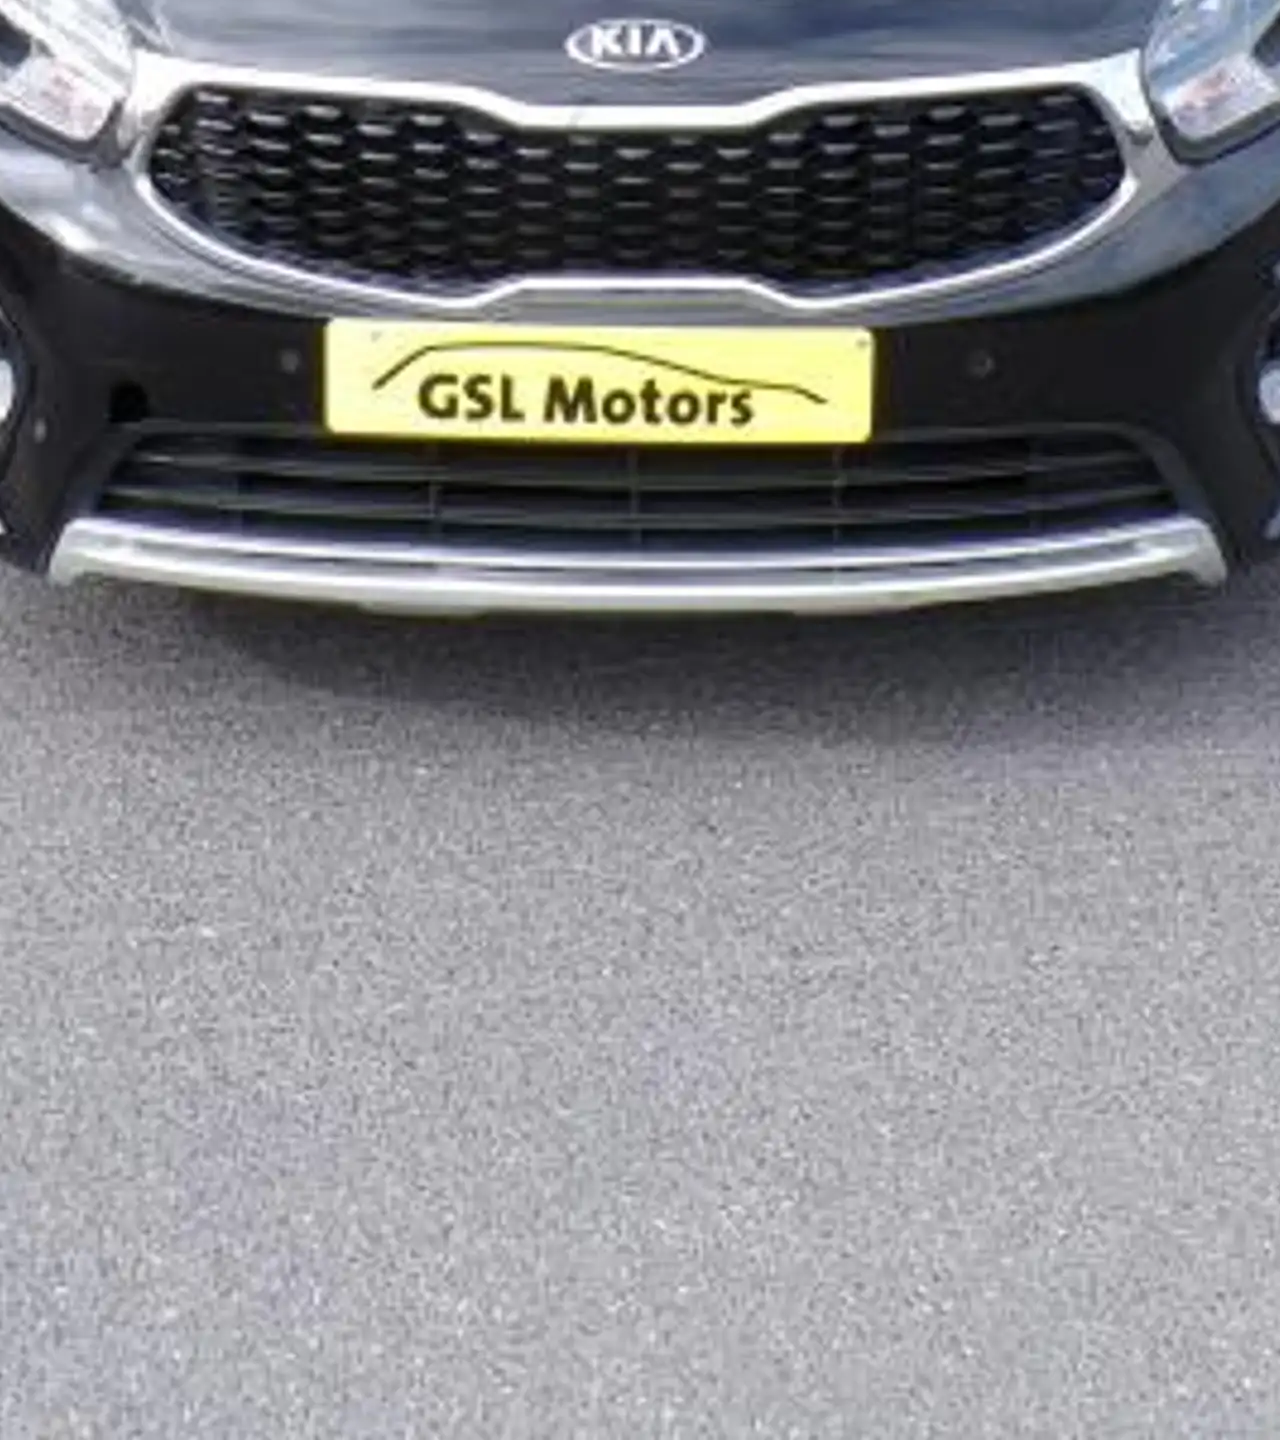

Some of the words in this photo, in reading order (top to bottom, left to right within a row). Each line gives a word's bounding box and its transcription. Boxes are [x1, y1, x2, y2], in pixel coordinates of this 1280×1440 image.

[591, 27, 680, 56] KIA
[420, 373, 525, 421] GSL
[543, 375, 756, 427] Motors
